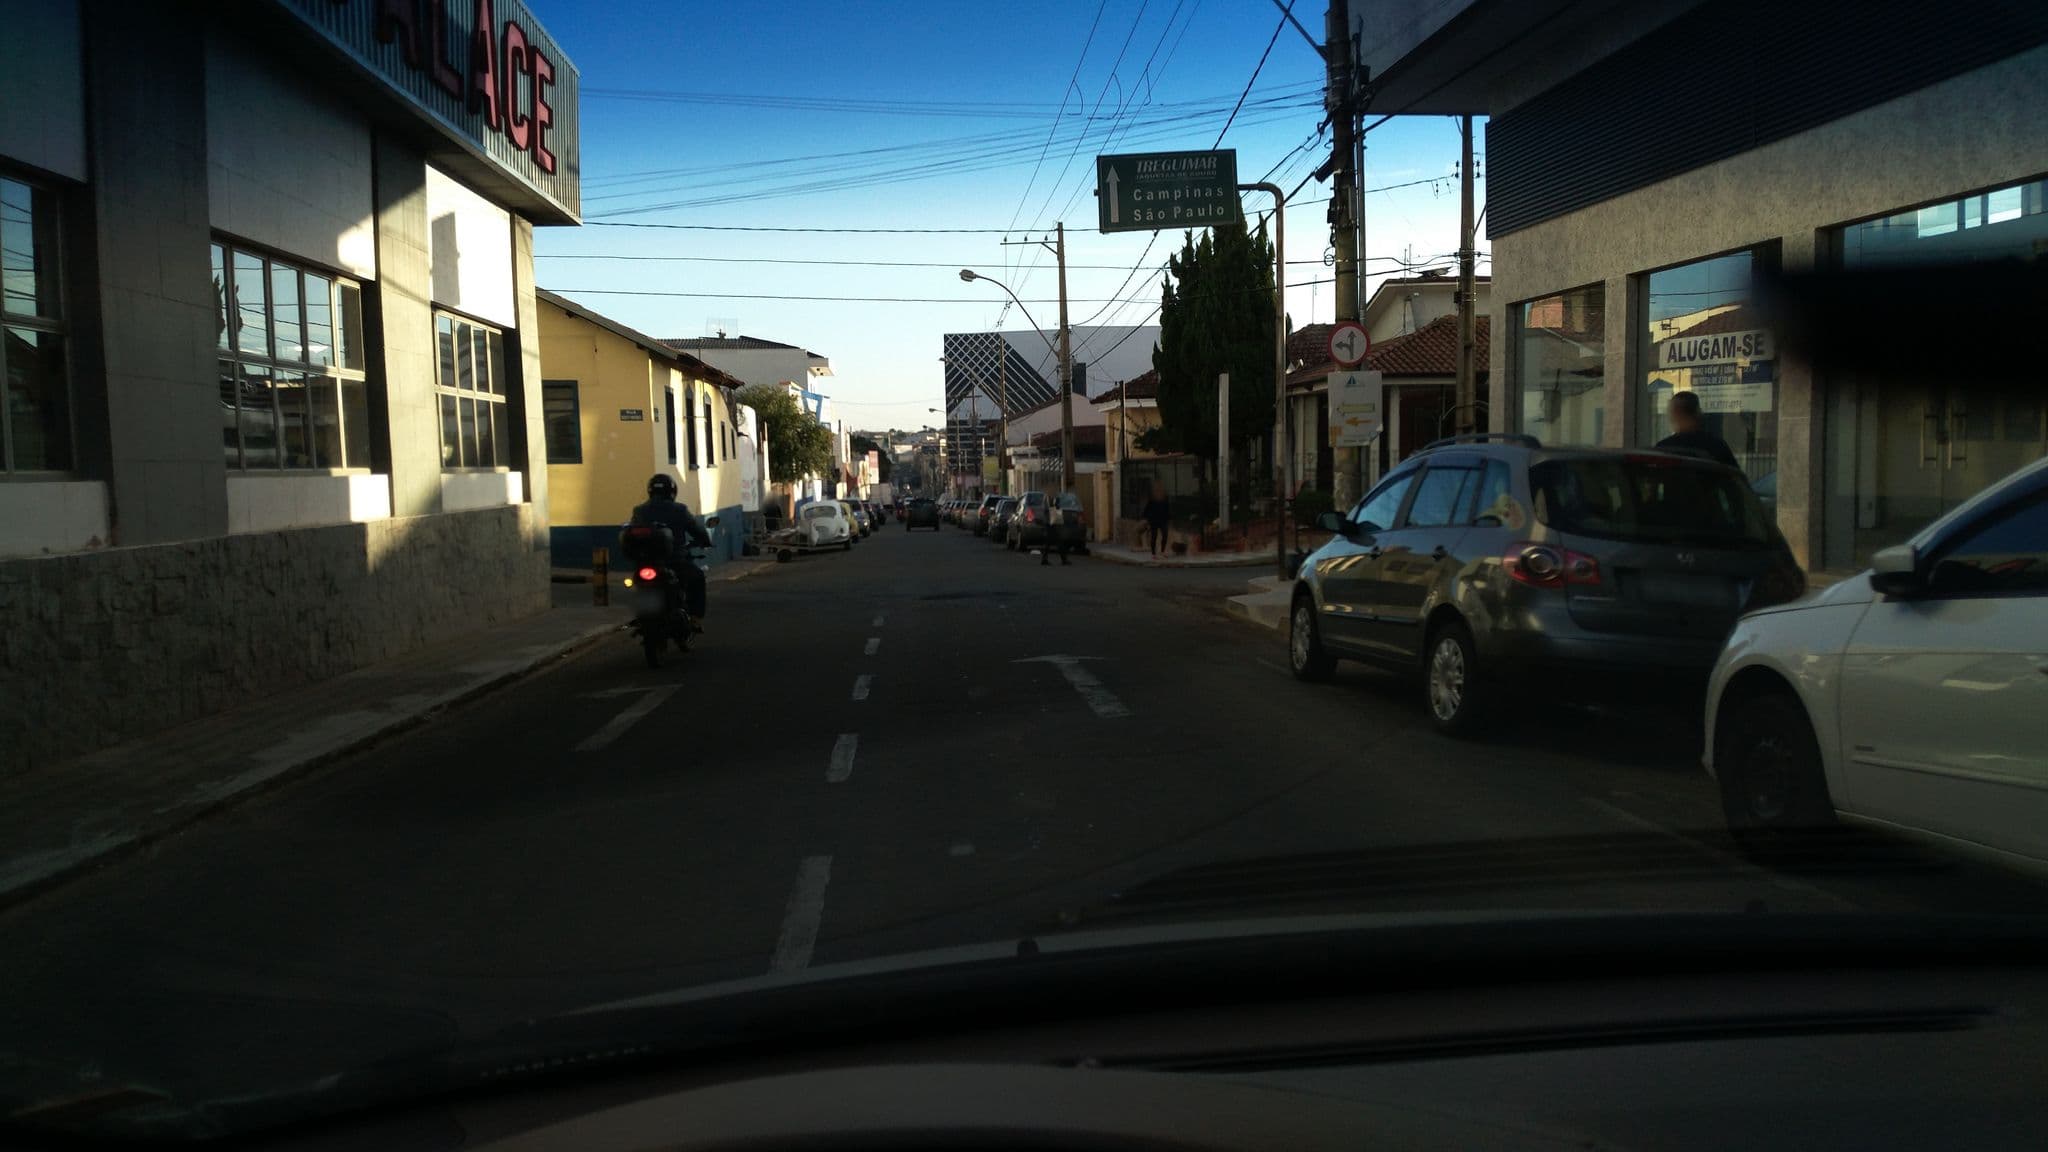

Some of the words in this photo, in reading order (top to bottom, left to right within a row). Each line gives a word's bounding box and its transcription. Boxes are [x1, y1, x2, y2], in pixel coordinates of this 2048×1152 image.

[333, 0, 556, 174] LACE
[1133, 185, 1224, 202] Campinas
[1133, 208, 1166, 222] São
[1173, 203, 1225, 219] Paulo
[1667, 333, 1765, 363] ALUGAM-SE
